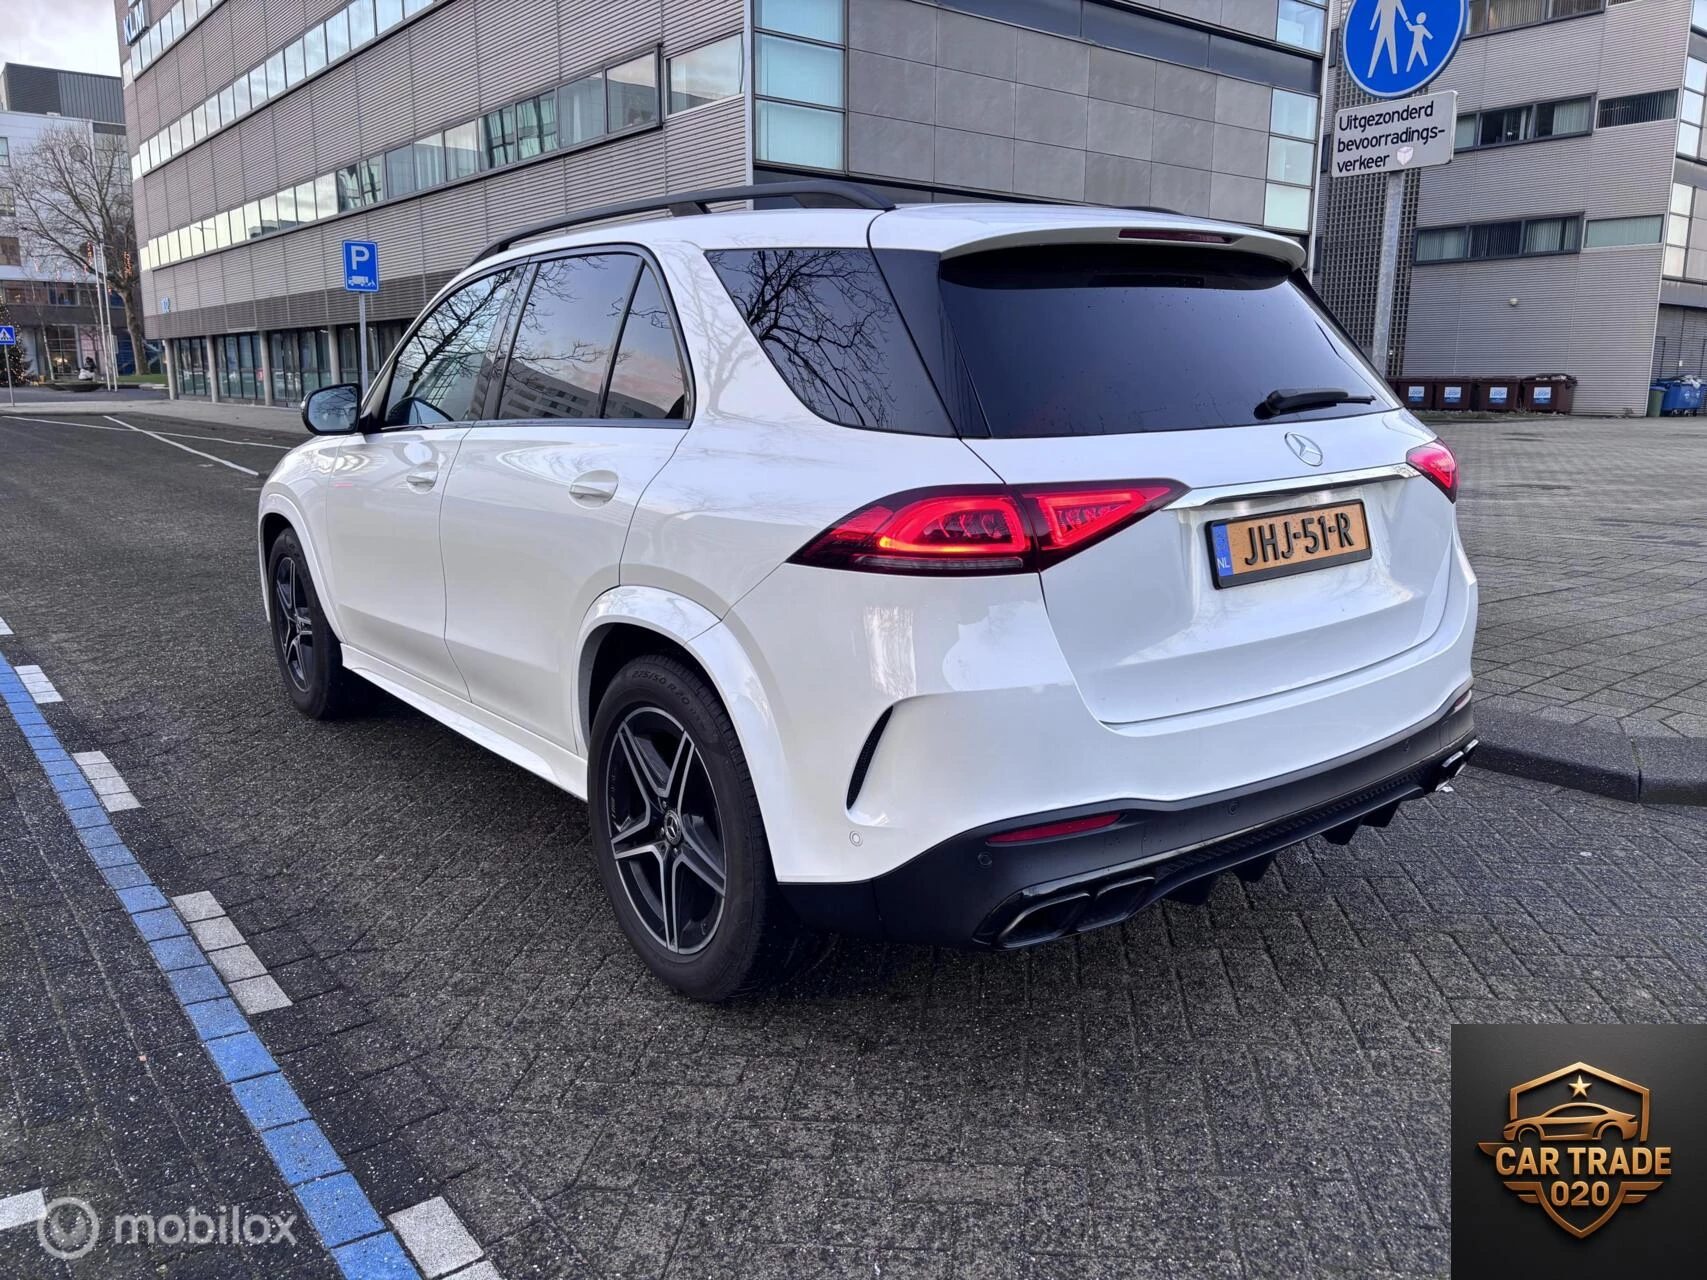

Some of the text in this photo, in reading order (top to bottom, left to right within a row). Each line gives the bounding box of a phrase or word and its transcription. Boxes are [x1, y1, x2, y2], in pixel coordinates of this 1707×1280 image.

[123, 1, 145, 45] KLM
[1339, 100, 1434, 132] Uitgezonderd
[1337, 126, 1446, 152] bevoorradings-
[1337, 154, 1390, 173] verkeer
[350, 245, 370, 270] P
[1244, 512, 1354, 565] JHJ-51-R
[1216, 557, 1231, 568] NL
